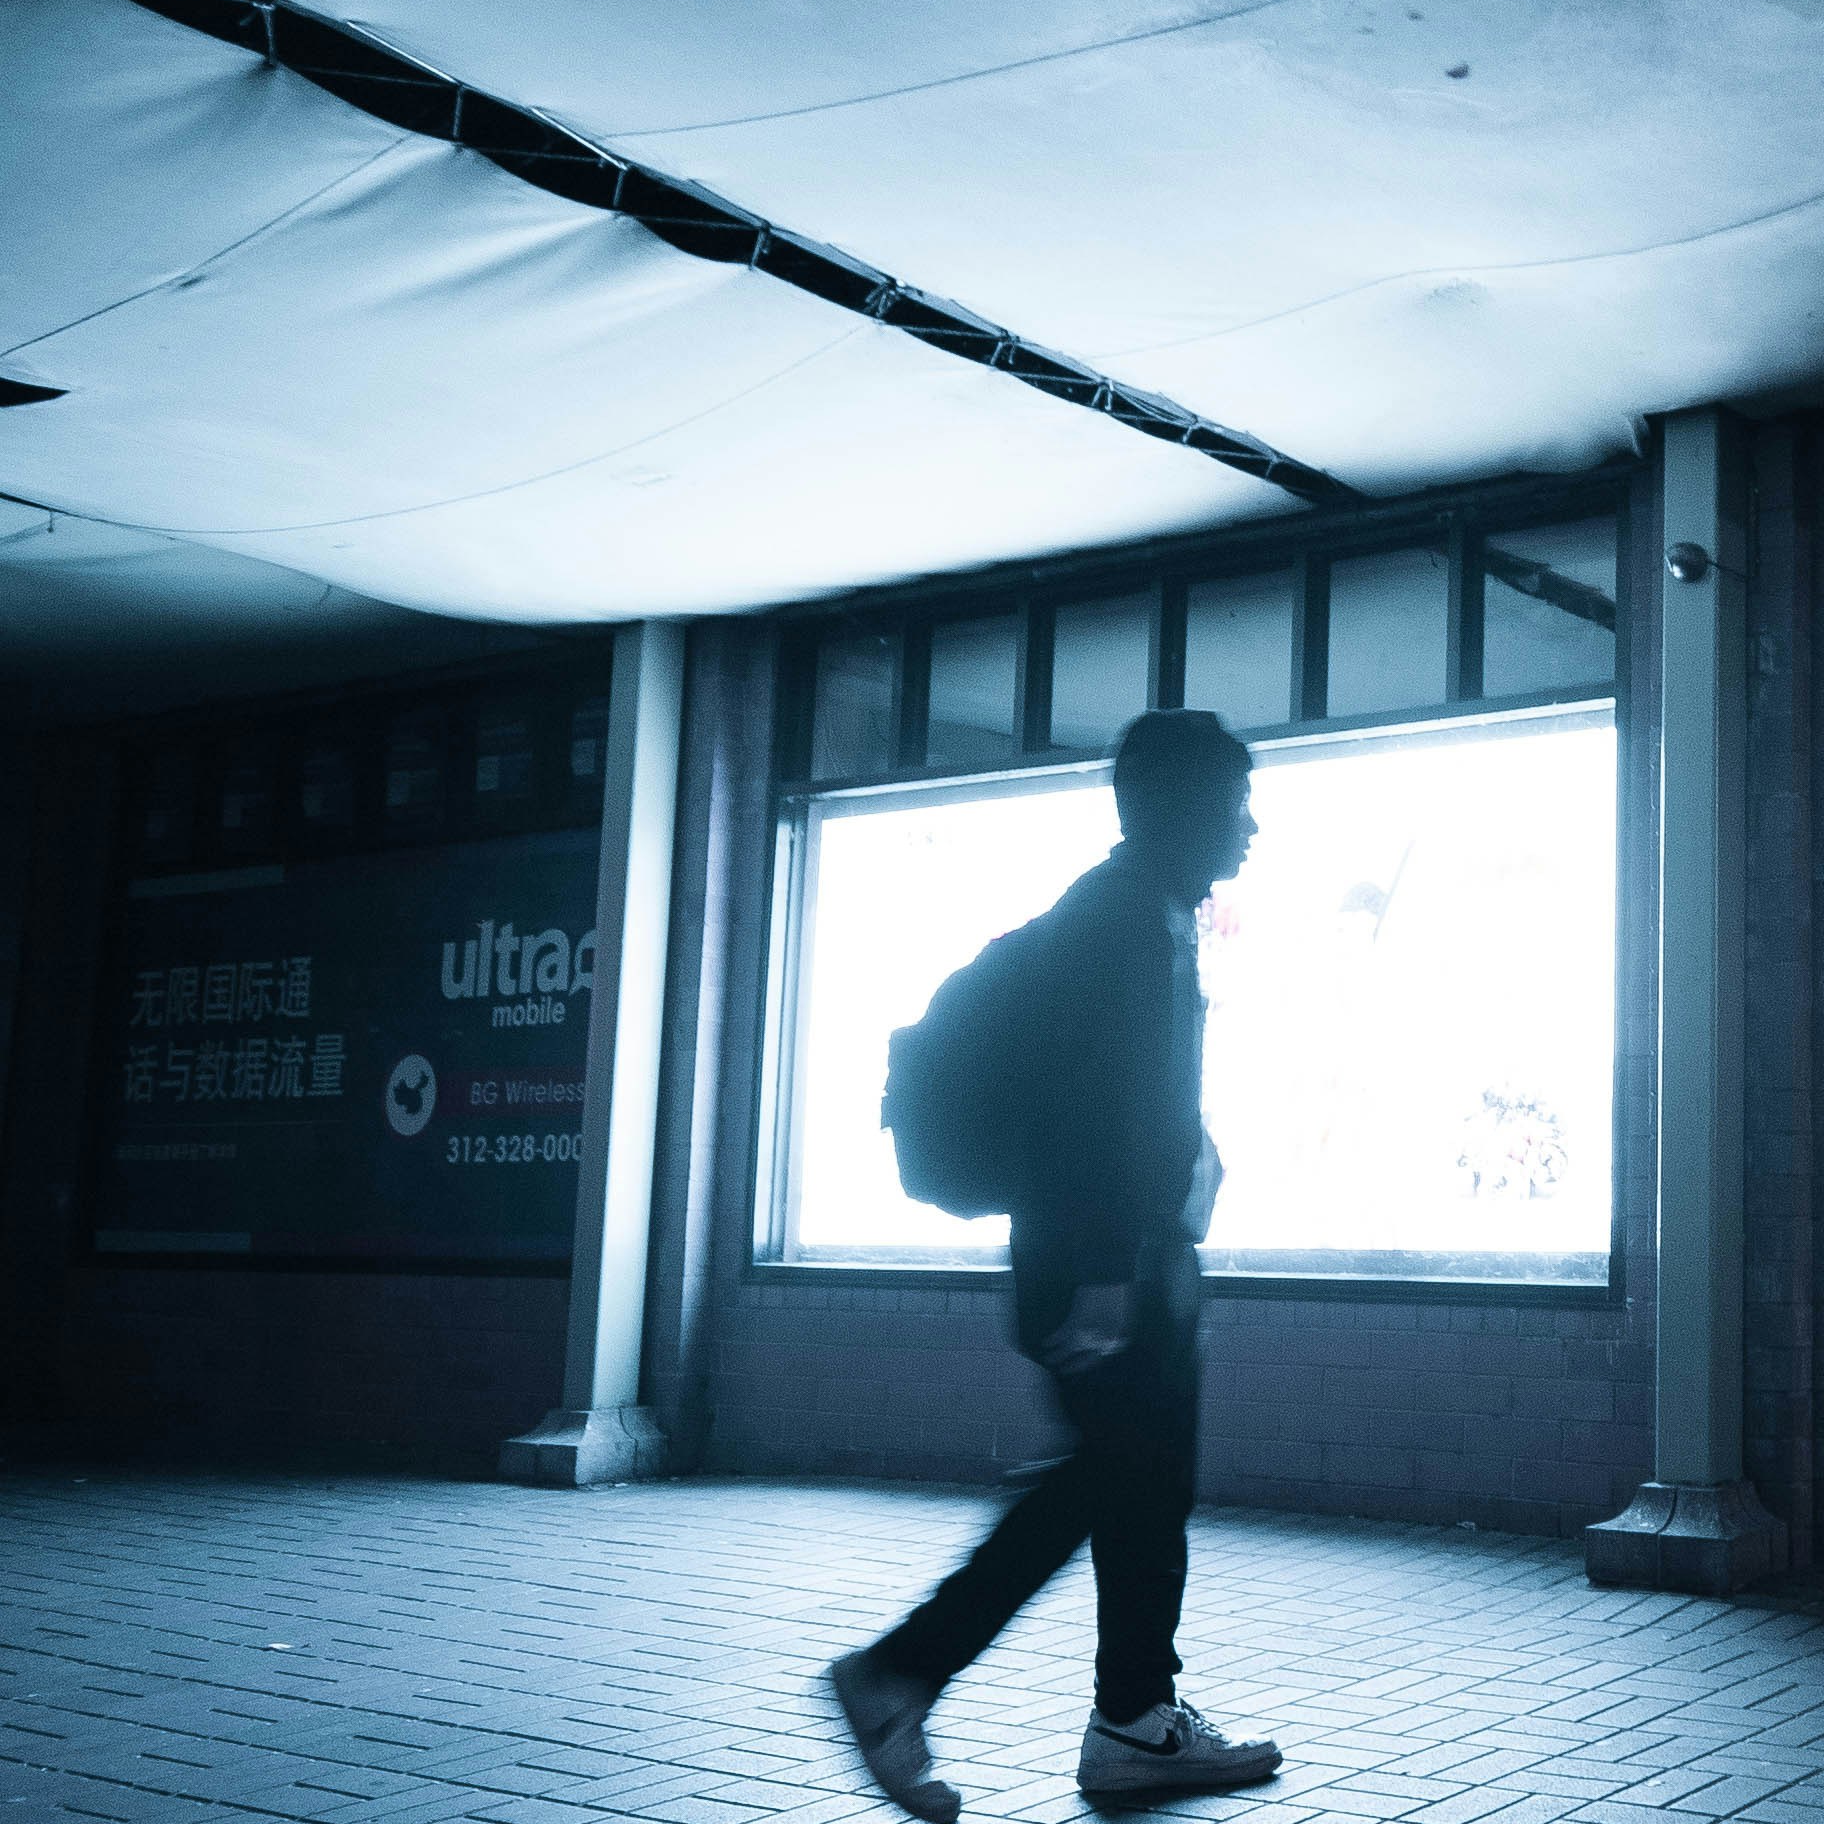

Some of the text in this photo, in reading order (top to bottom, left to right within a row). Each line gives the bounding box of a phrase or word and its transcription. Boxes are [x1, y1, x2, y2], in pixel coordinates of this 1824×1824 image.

[128, 955, 313, 1026] 无限国际通
[491, 996, 567, 1027] mobile
[123, 1034, 347, 1103] 话与数据流量
[471, 1078, 586, 1106] BG Wireless
[446, 1133, 584, 1164] 312-328-000
